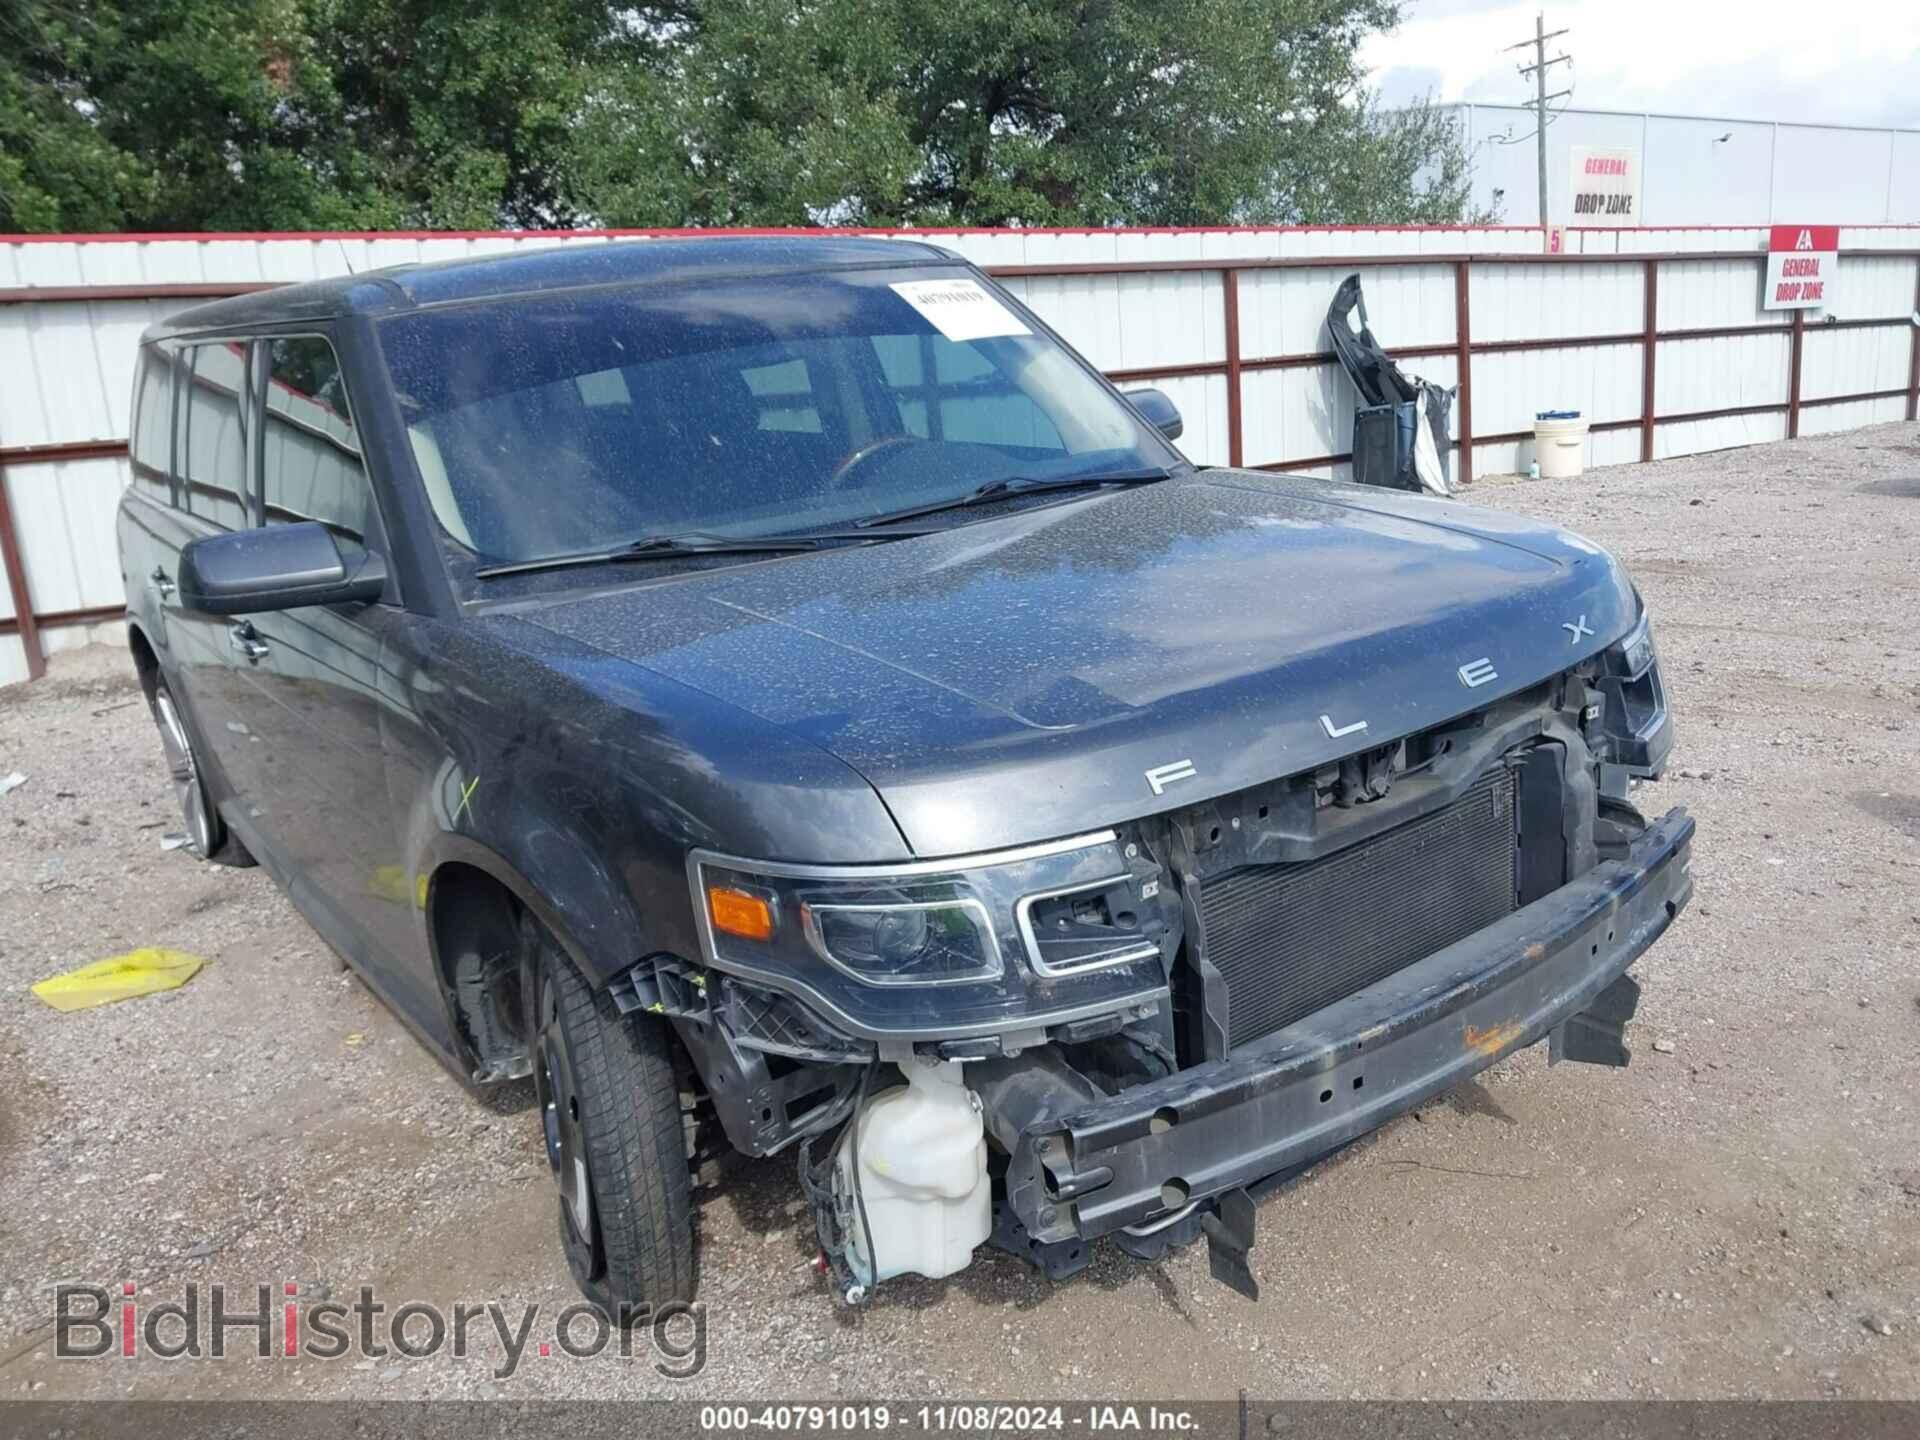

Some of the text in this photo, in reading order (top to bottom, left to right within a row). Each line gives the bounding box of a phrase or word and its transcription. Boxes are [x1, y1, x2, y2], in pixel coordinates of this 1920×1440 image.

[1584, 158, 1627, 175] GENERAL
[1574, 194, 1632, 214] DROP ZONE
[1551, 230, 1560, 253] 5
[1782, 258, 1820, 277] GENERAL
[1776, 281, 1824, 301] DROP ZONE
